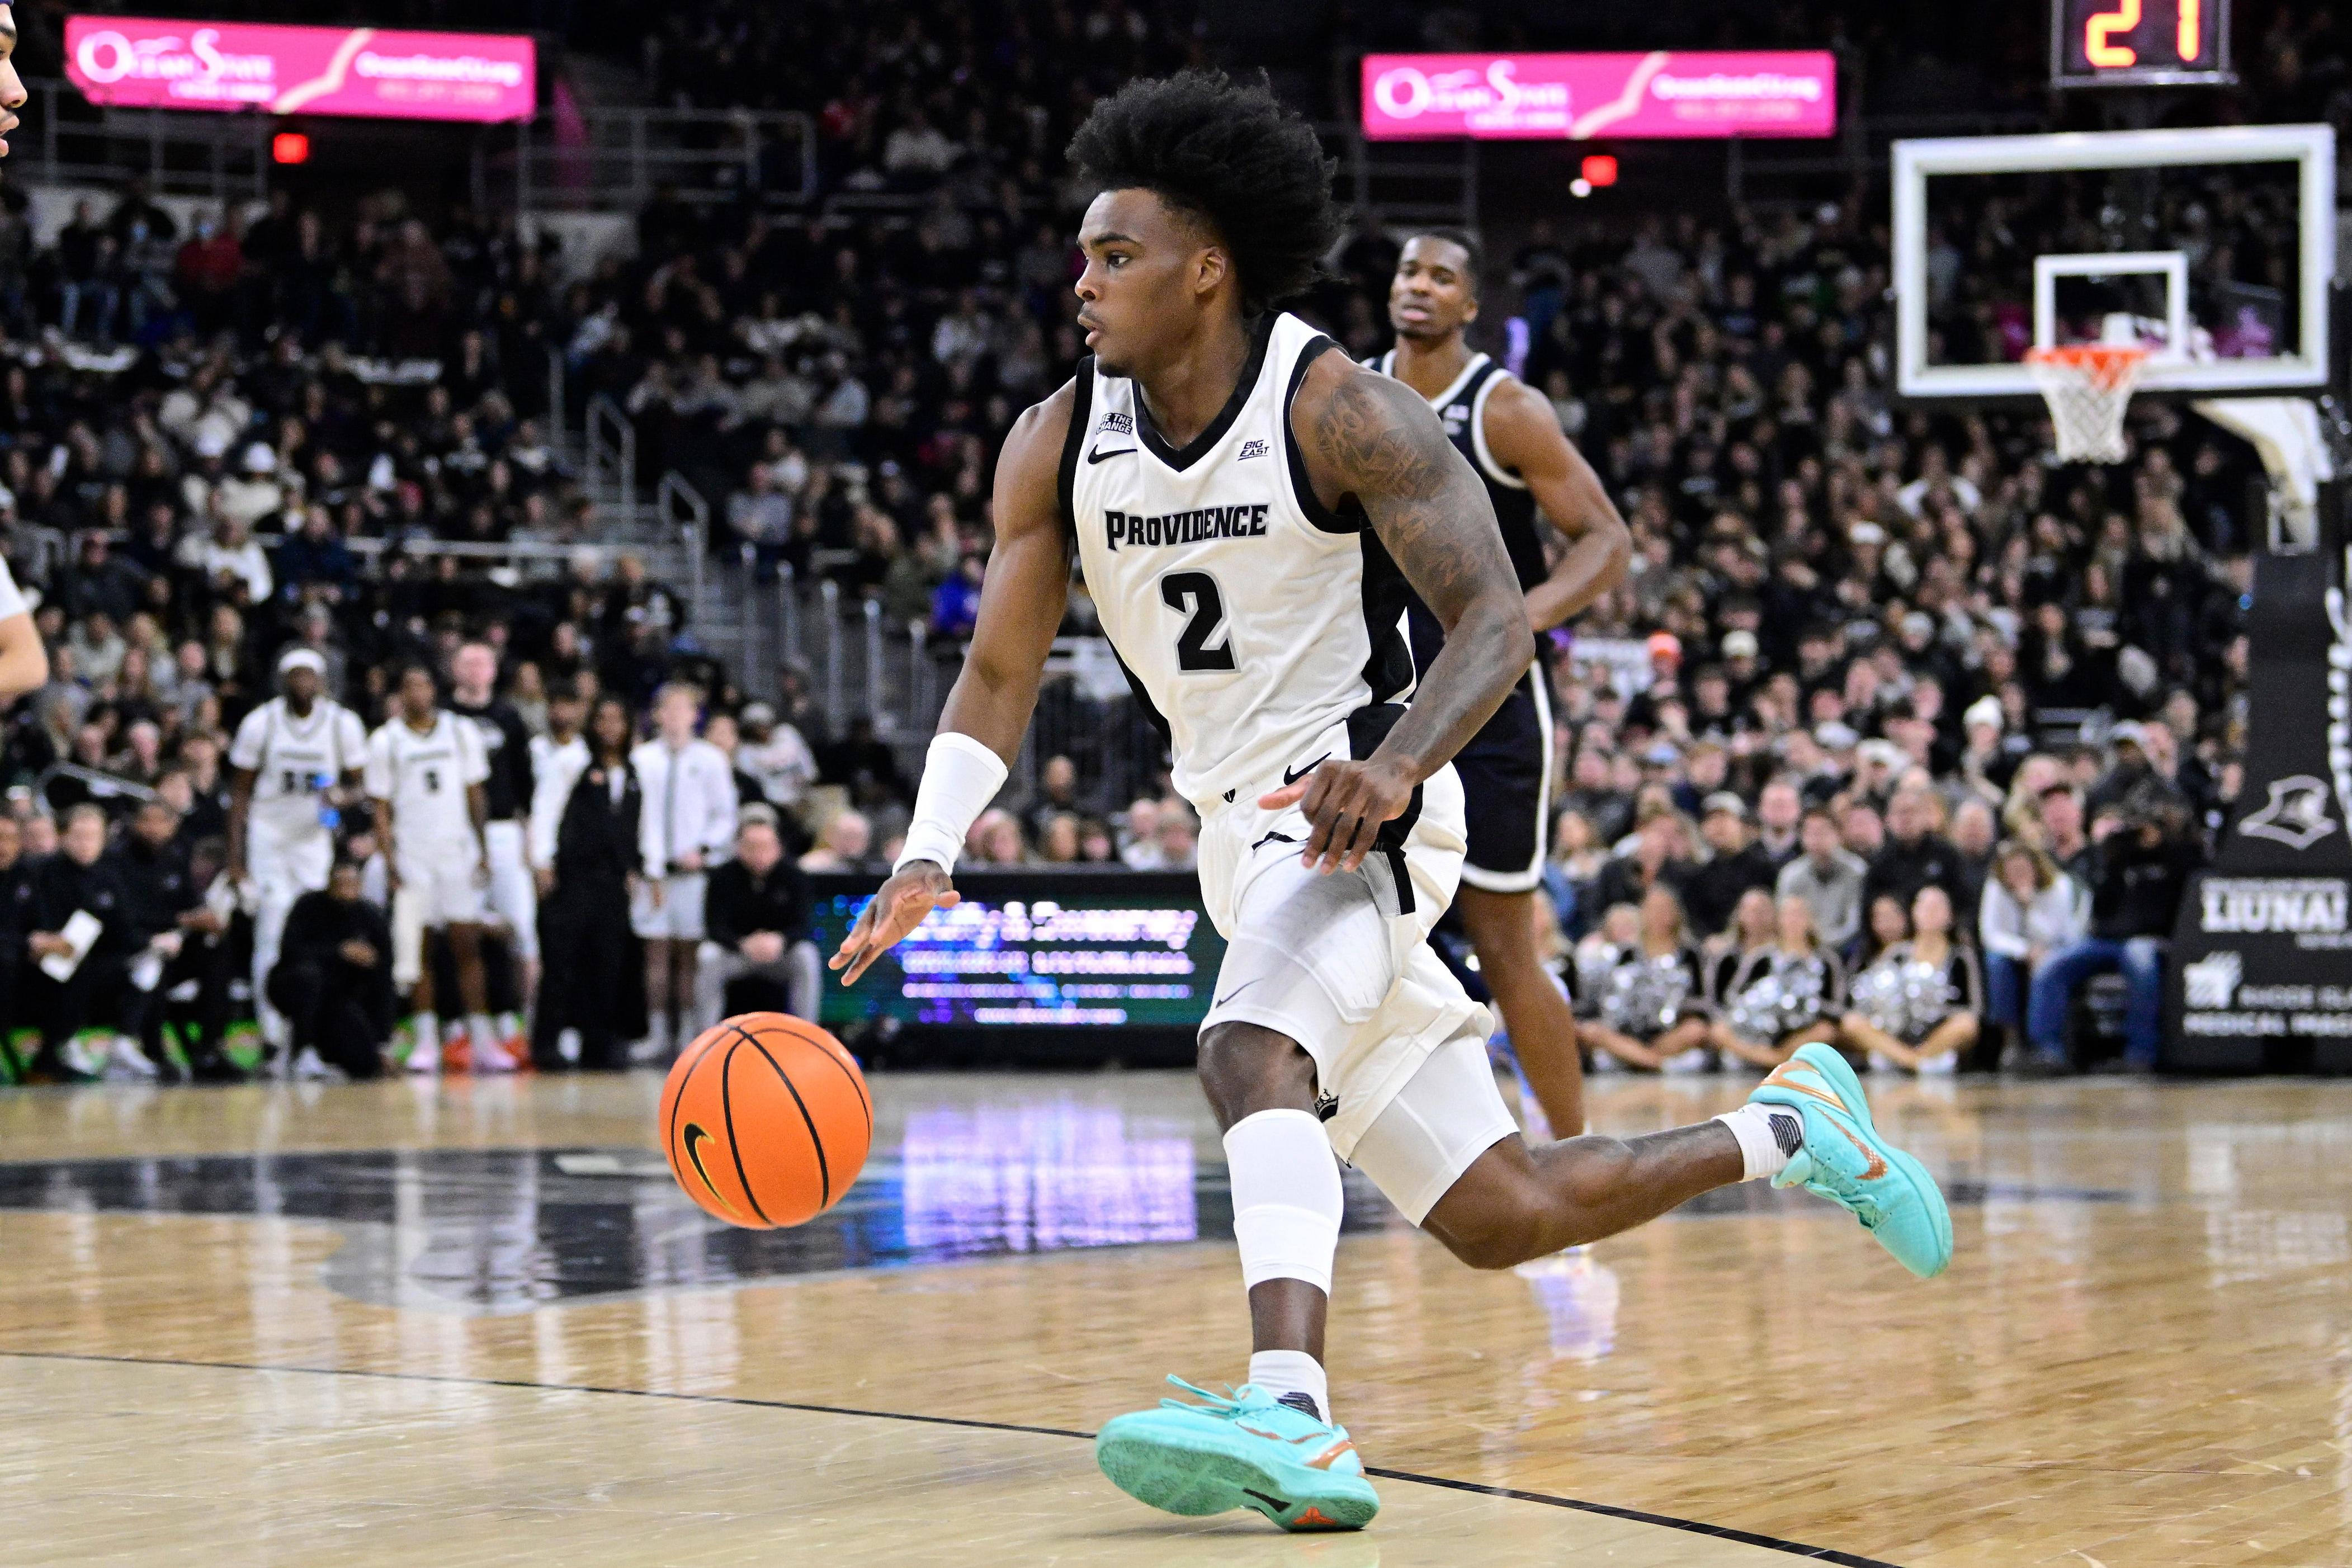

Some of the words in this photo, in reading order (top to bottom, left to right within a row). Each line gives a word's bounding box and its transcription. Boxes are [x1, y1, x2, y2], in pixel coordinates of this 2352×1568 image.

[1113, 414, 1132, 426] THE
[1096, 421, 1132, 434] CHANGE
[1243, 440, 1264, 449] BIG
[1239, 446, 1270, 457] EAST
[1104, 503, 1269, 551] PROVIDENCE
[1159, 570, 1238, 672] 2
